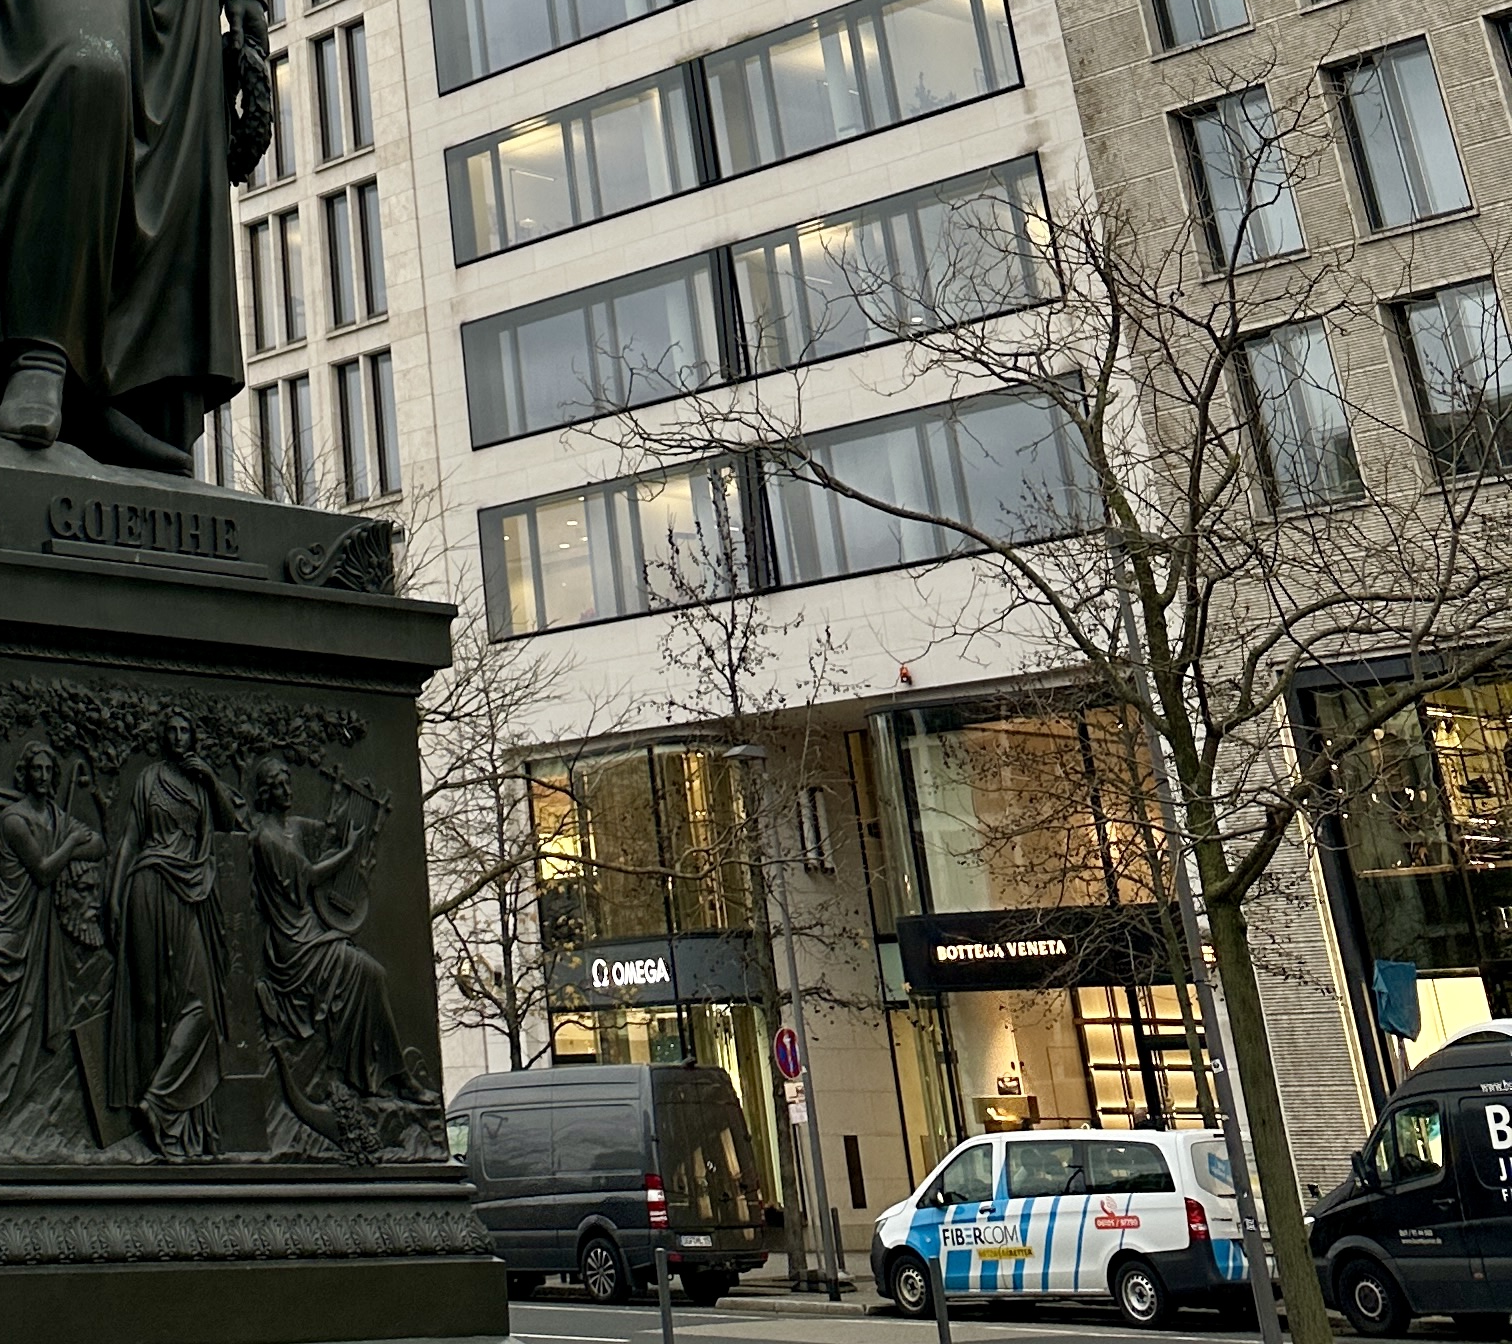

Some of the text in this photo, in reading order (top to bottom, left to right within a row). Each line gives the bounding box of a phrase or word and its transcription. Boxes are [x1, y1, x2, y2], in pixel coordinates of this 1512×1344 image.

[48, 494, 240, 559] GOETHE
[937, 940, 1067, 961] BOTTEGA VENETA
[612, 957, 670, 985] OMEGA
[942, 1224, 1019, 1246] FIBERCOM
